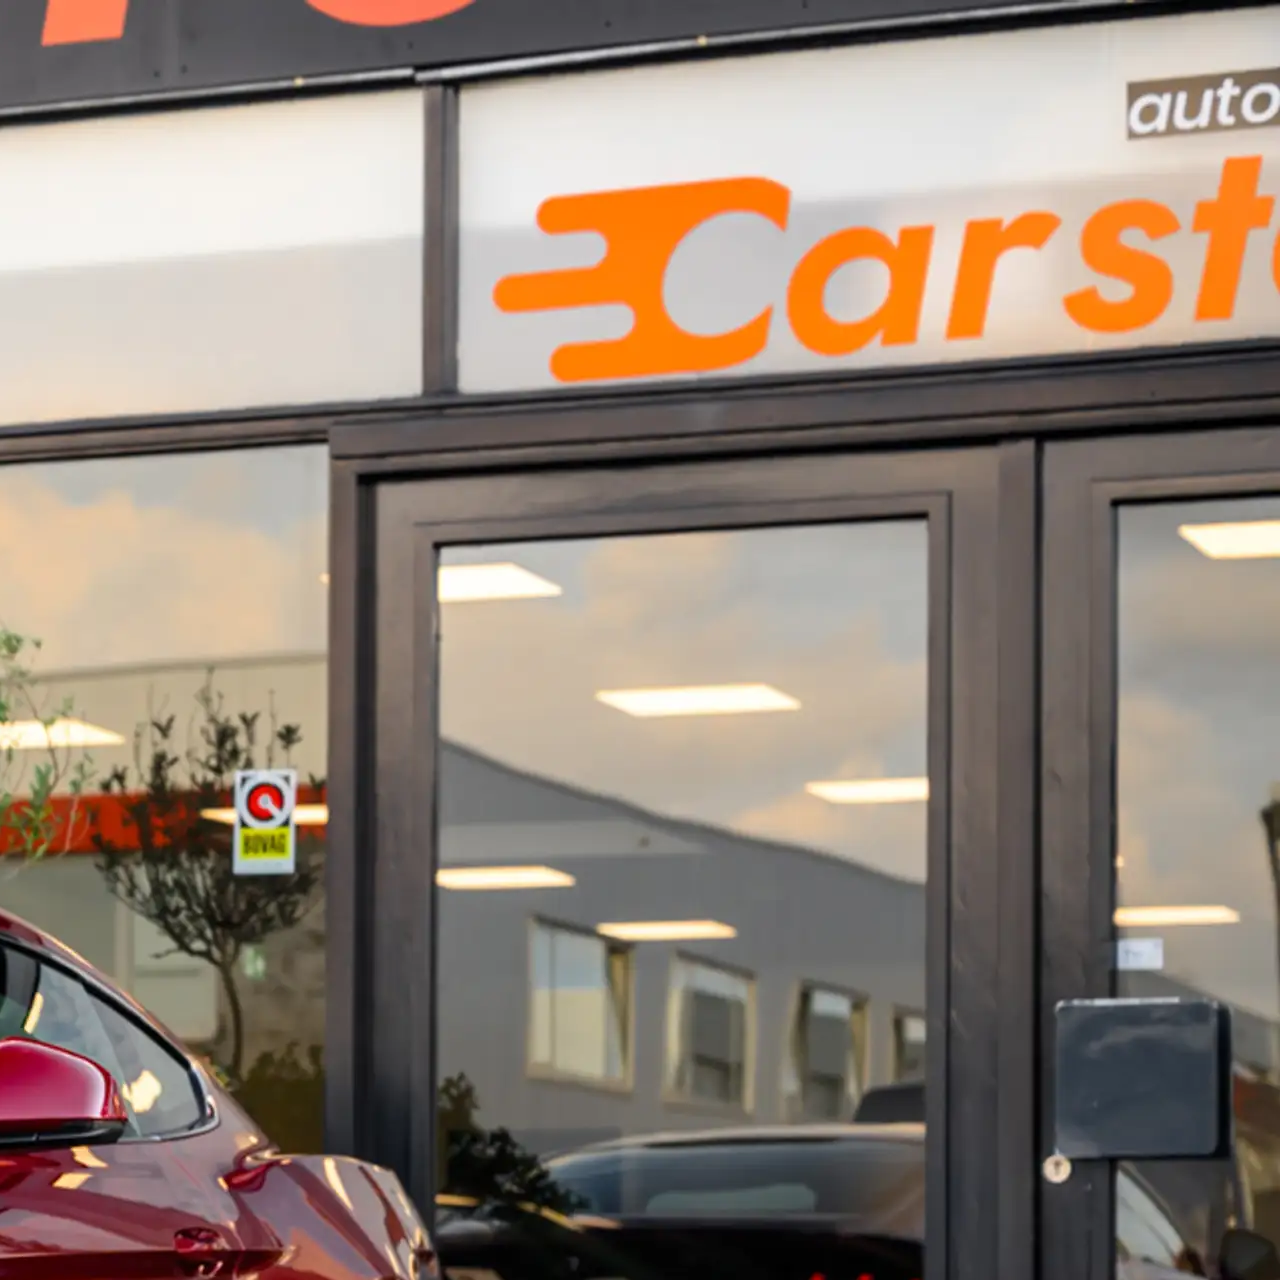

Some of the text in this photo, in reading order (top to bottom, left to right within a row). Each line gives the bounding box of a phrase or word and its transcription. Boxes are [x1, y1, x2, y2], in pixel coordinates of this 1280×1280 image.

[1128, 78, 1280, 135] auto
[492, 154, 1280, 383] Carst
[243, 834, 286, 855] BOVAG
